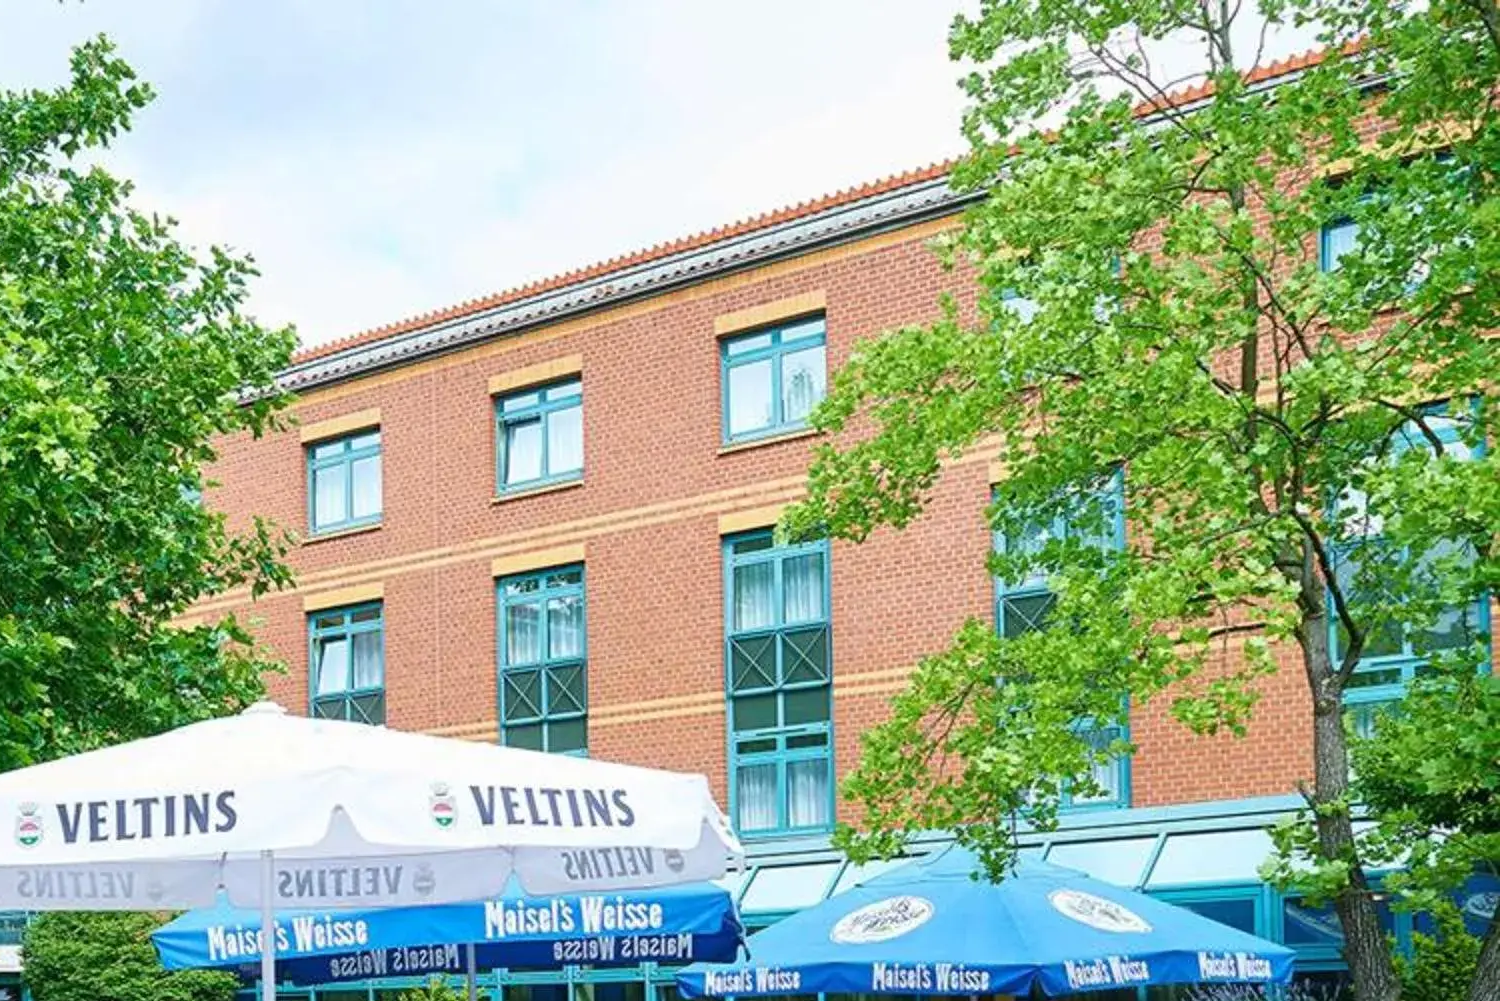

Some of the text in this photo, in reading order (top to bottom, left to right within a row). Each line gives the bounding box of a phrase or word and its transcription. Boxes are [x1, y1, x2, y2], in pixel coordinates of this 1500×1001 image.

[56, 790, 237, 843] VELTINS
[469, 785, 636, 828] VELTINS
[484, 896, 664, 940] Maisel's Weisse
[207, 914, 369, 961] Maise's Weisse
[704, 966, 800, 996] Maisel's Weisse
[873, 962, 990, 991] Maisel's Weisse
[1108, 955, 1150, 985] Weisse
[1235, 951, 1272, 981] Weisse
